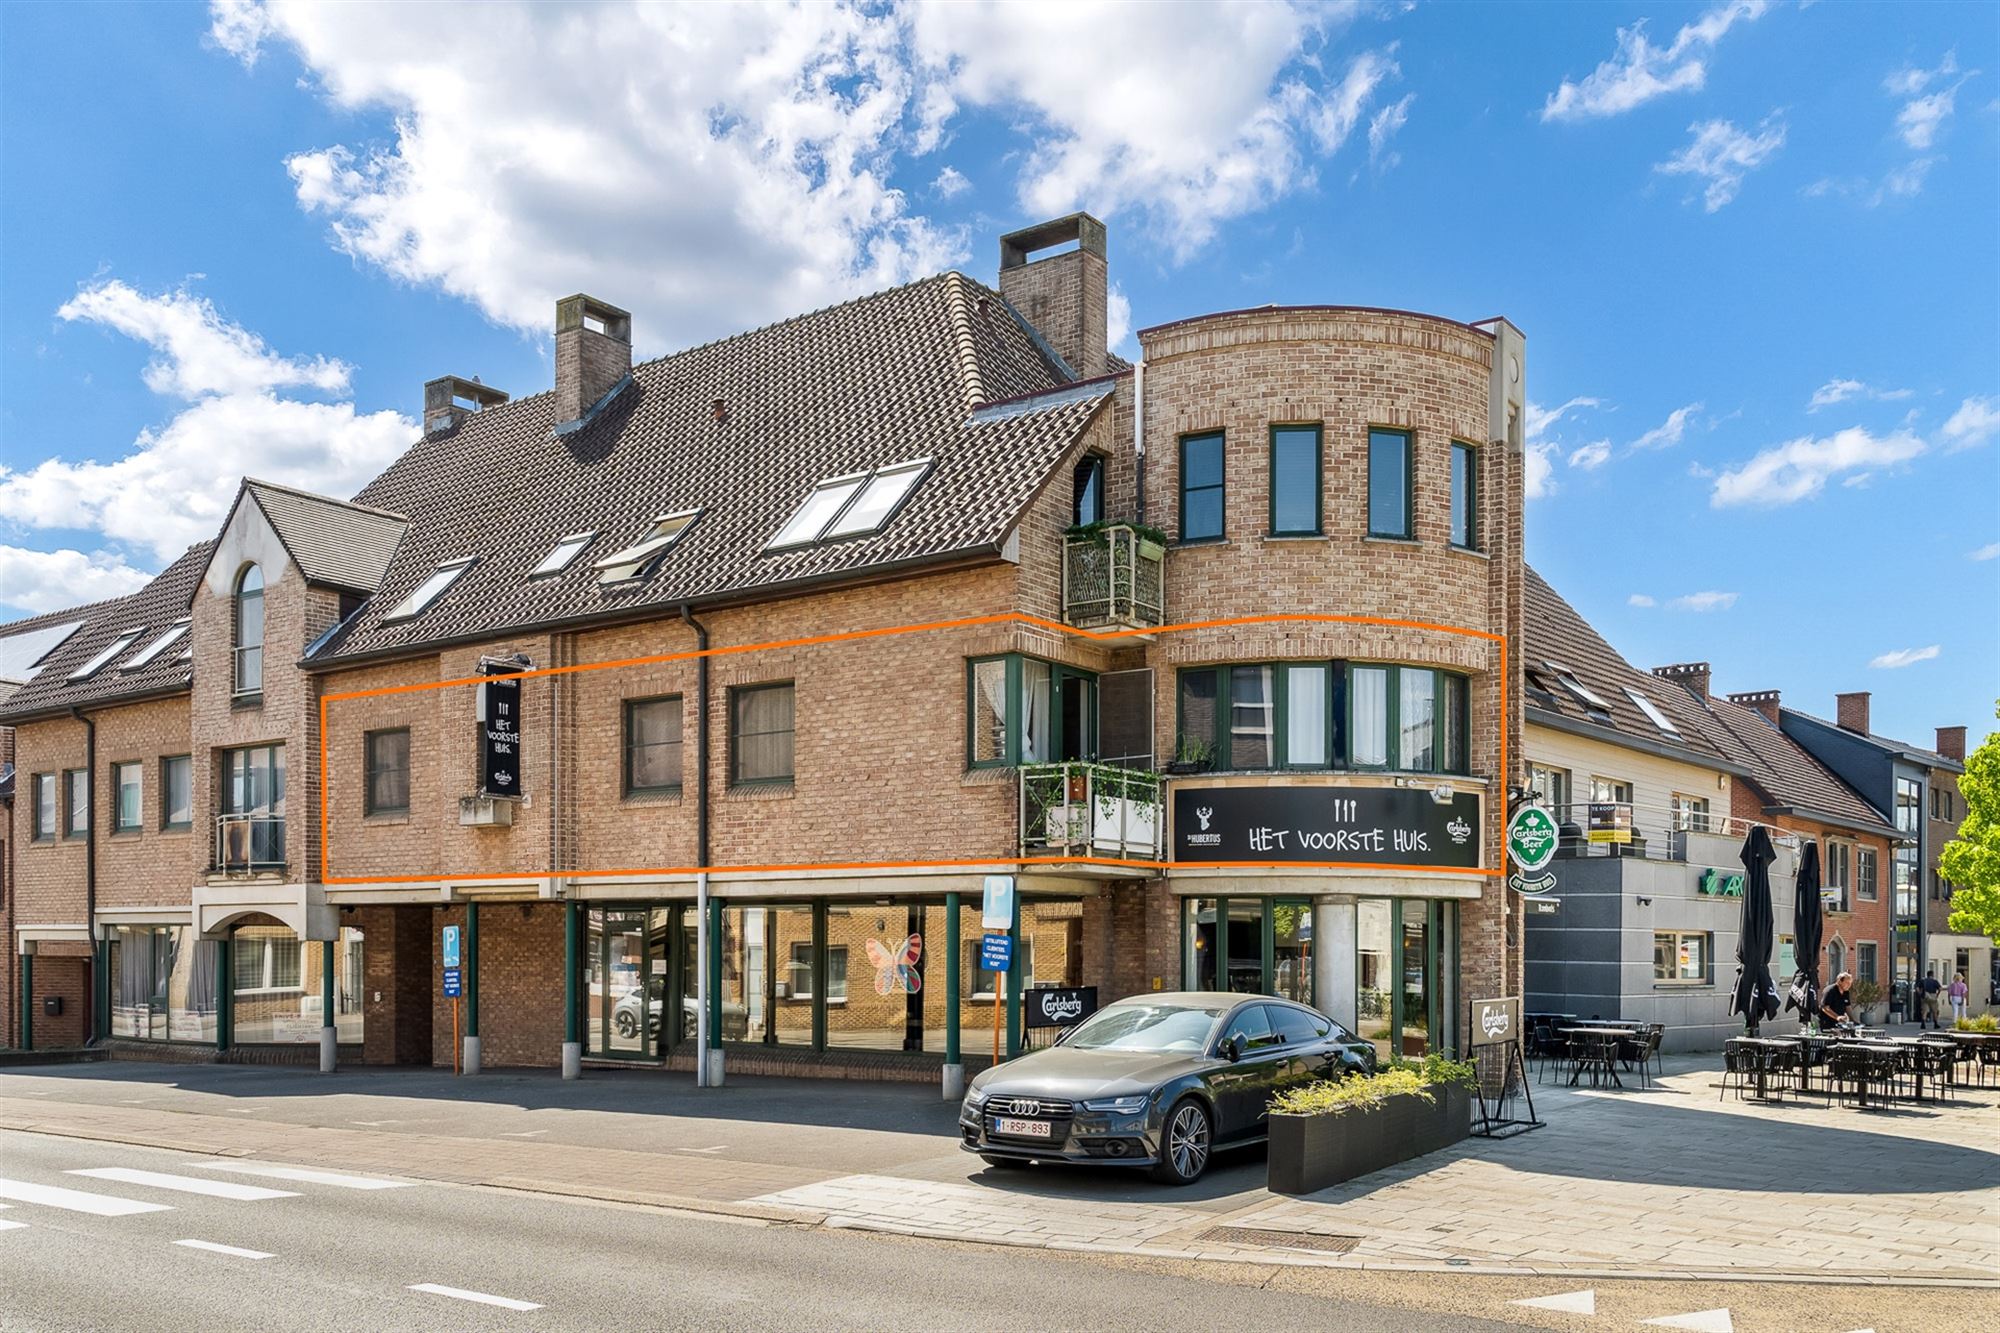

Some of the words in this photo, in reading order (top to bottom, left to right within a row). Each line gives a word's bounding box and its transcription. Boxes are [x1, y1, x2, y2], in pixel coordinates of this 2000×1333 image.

[495, 719, 511, 731] HET
[487, 731, 520, 743] VOORSTE
[1191, 833, 1221, 843] HUBERTUS
[1249, 826, 1289, 851] HET
[1298, 828, 1385, 852] VOORSTE
[1393, 829, 1431, 852] HUIS.
[1512, 826, 1552, 841] Carlsberg
[1522, 839, 1543, 848] Beer
[990, 879, 1006, 907] P
[446, 929, 456, 951] P
[1041, 992, 1082, 1019] Carlsberg
[1481, 1005, 1509, 1035] Carlsberg
[1001, 1121, 1049, 1134] 1-RSP-893
